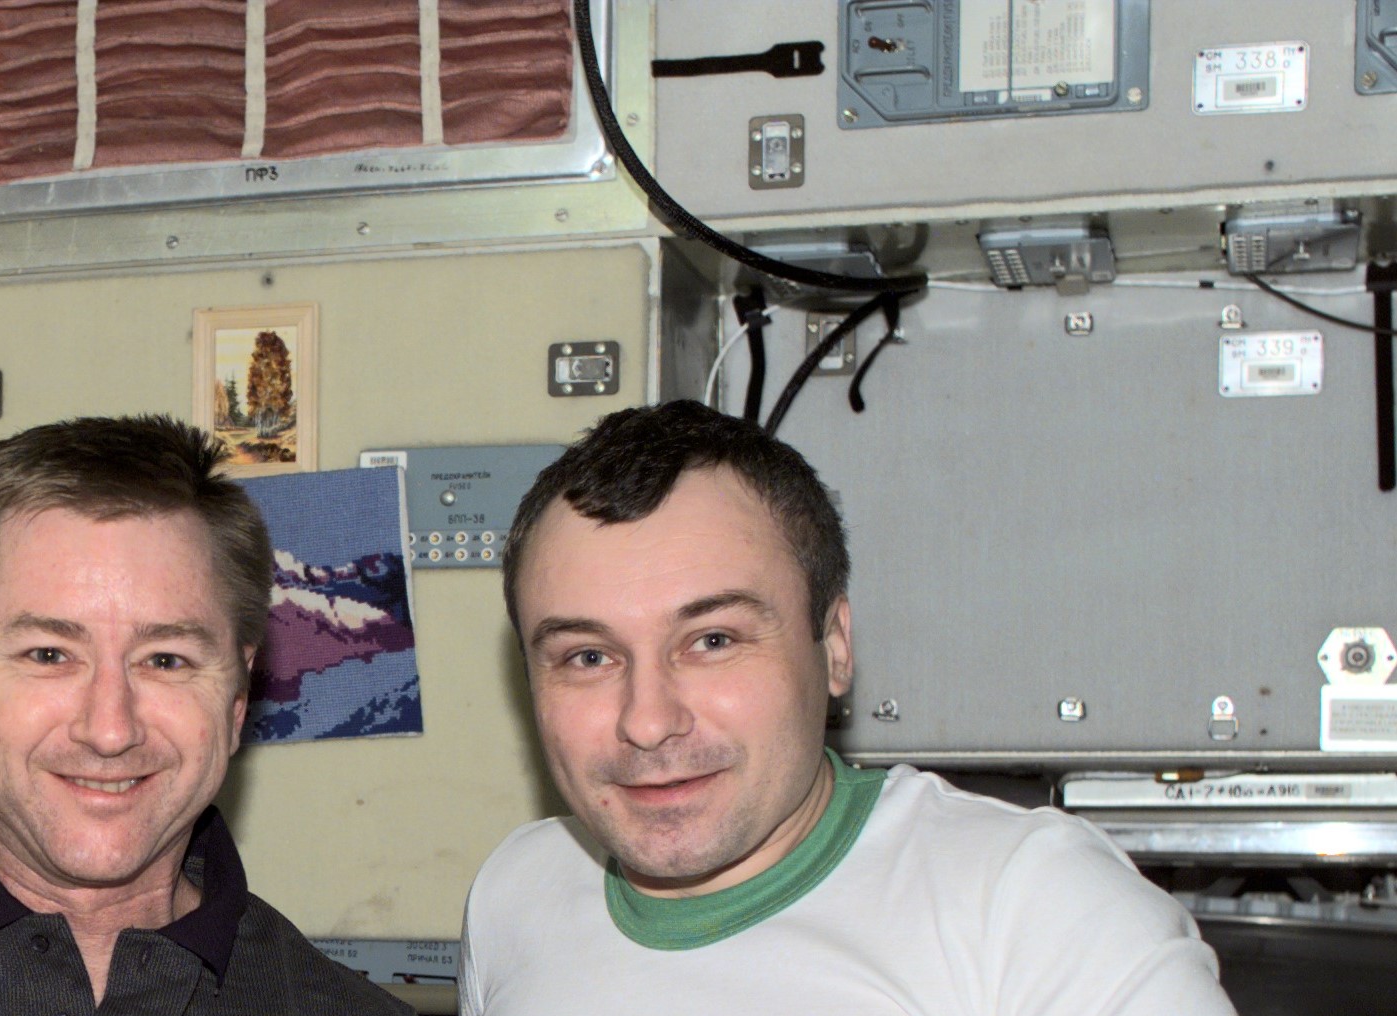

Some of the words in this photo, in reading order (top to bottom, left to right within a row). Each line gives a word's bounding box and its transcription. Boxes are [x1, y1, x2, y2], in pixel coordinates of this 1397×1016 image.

[1235, 50, 1277, 70] 338
[1256, 338, 1294, 357] 339
[430, 470, 491, 481] ПРЕДОХРАНИТЕЛИ
[406, 953, 440, 963] ПРИЧАЛ
